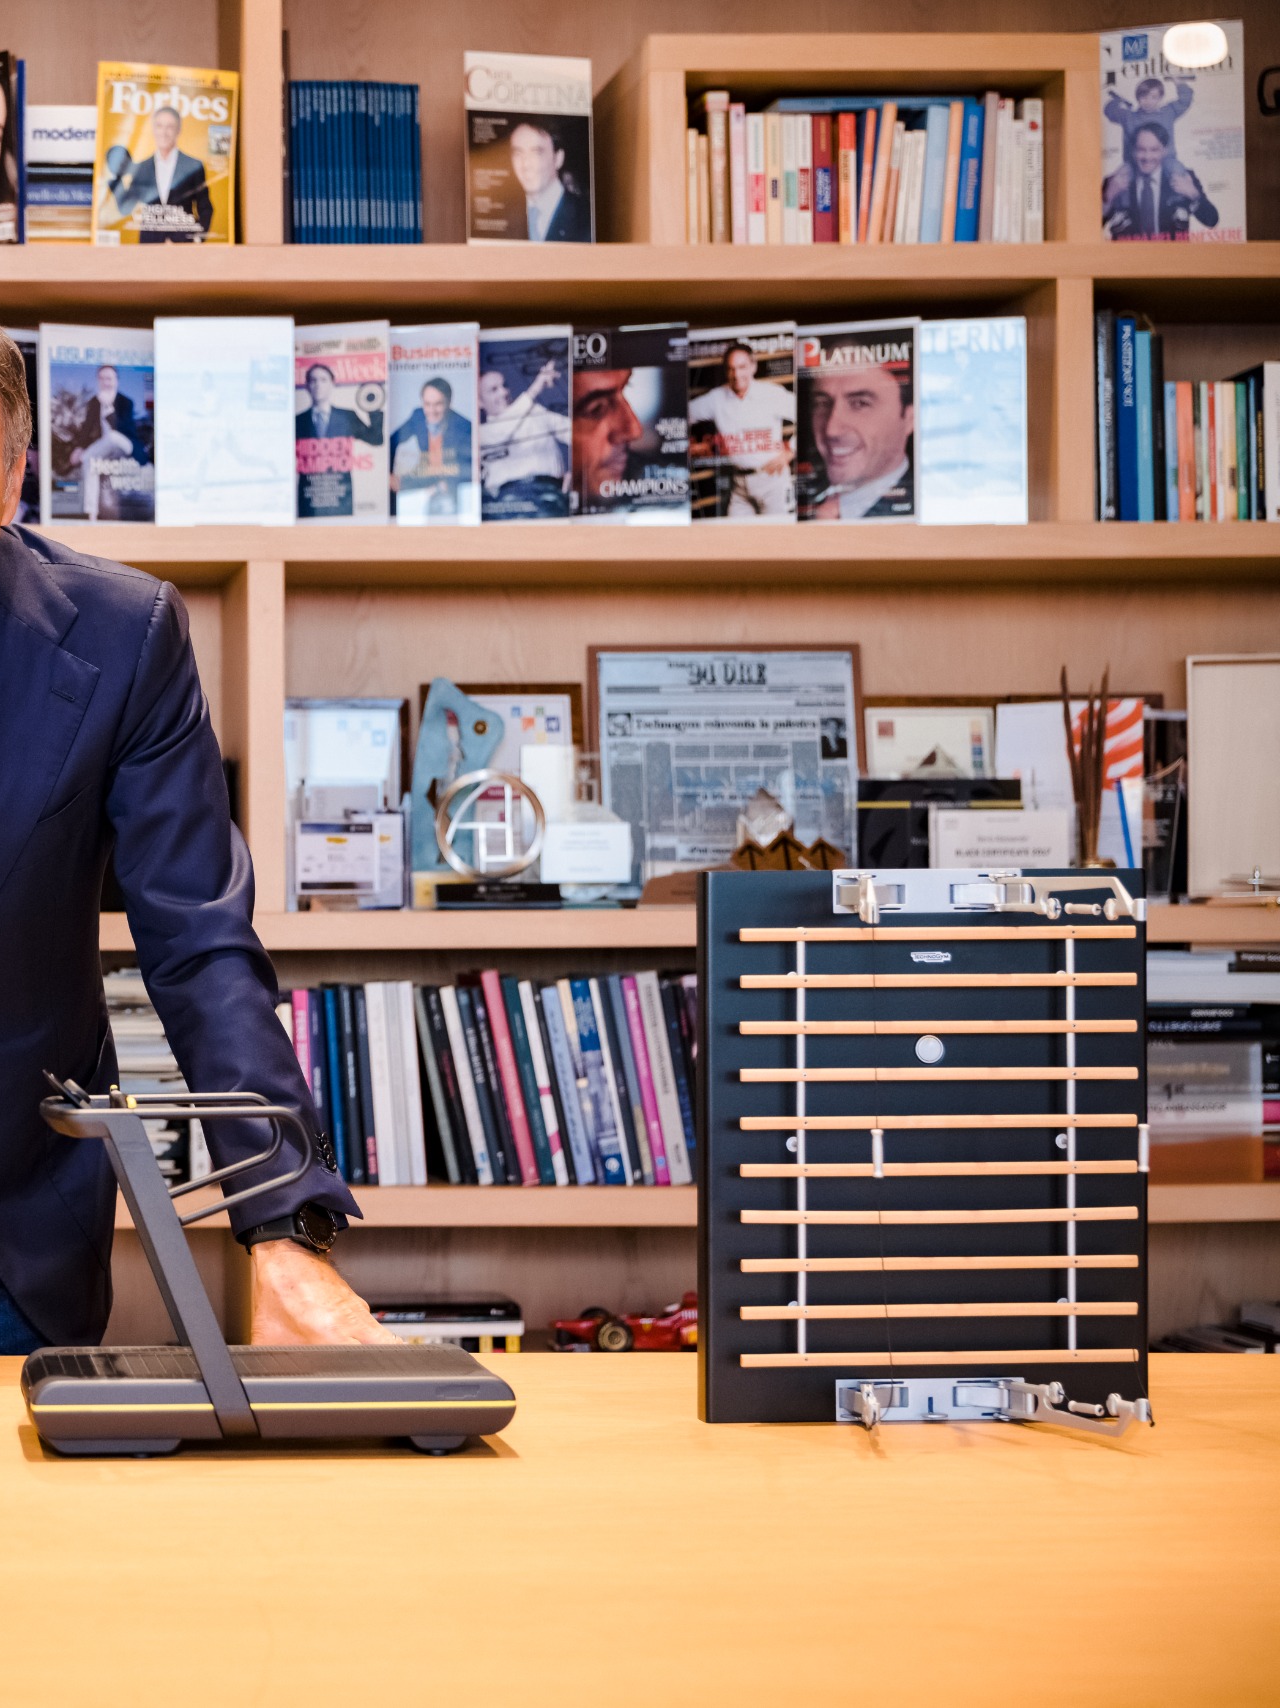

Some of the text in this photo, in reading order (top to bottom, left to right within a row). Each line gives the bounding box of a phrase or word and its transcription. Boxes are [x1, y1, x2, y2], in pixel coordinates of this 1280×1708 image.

[110, 81, 229, 122] Forbes
[392, 344, 472, 361] Business
[572, 332, 607, 359] EO
[804, 336, 910, 367] PLATINUM
[599, 477, 689, 498] CHAMPIONS
